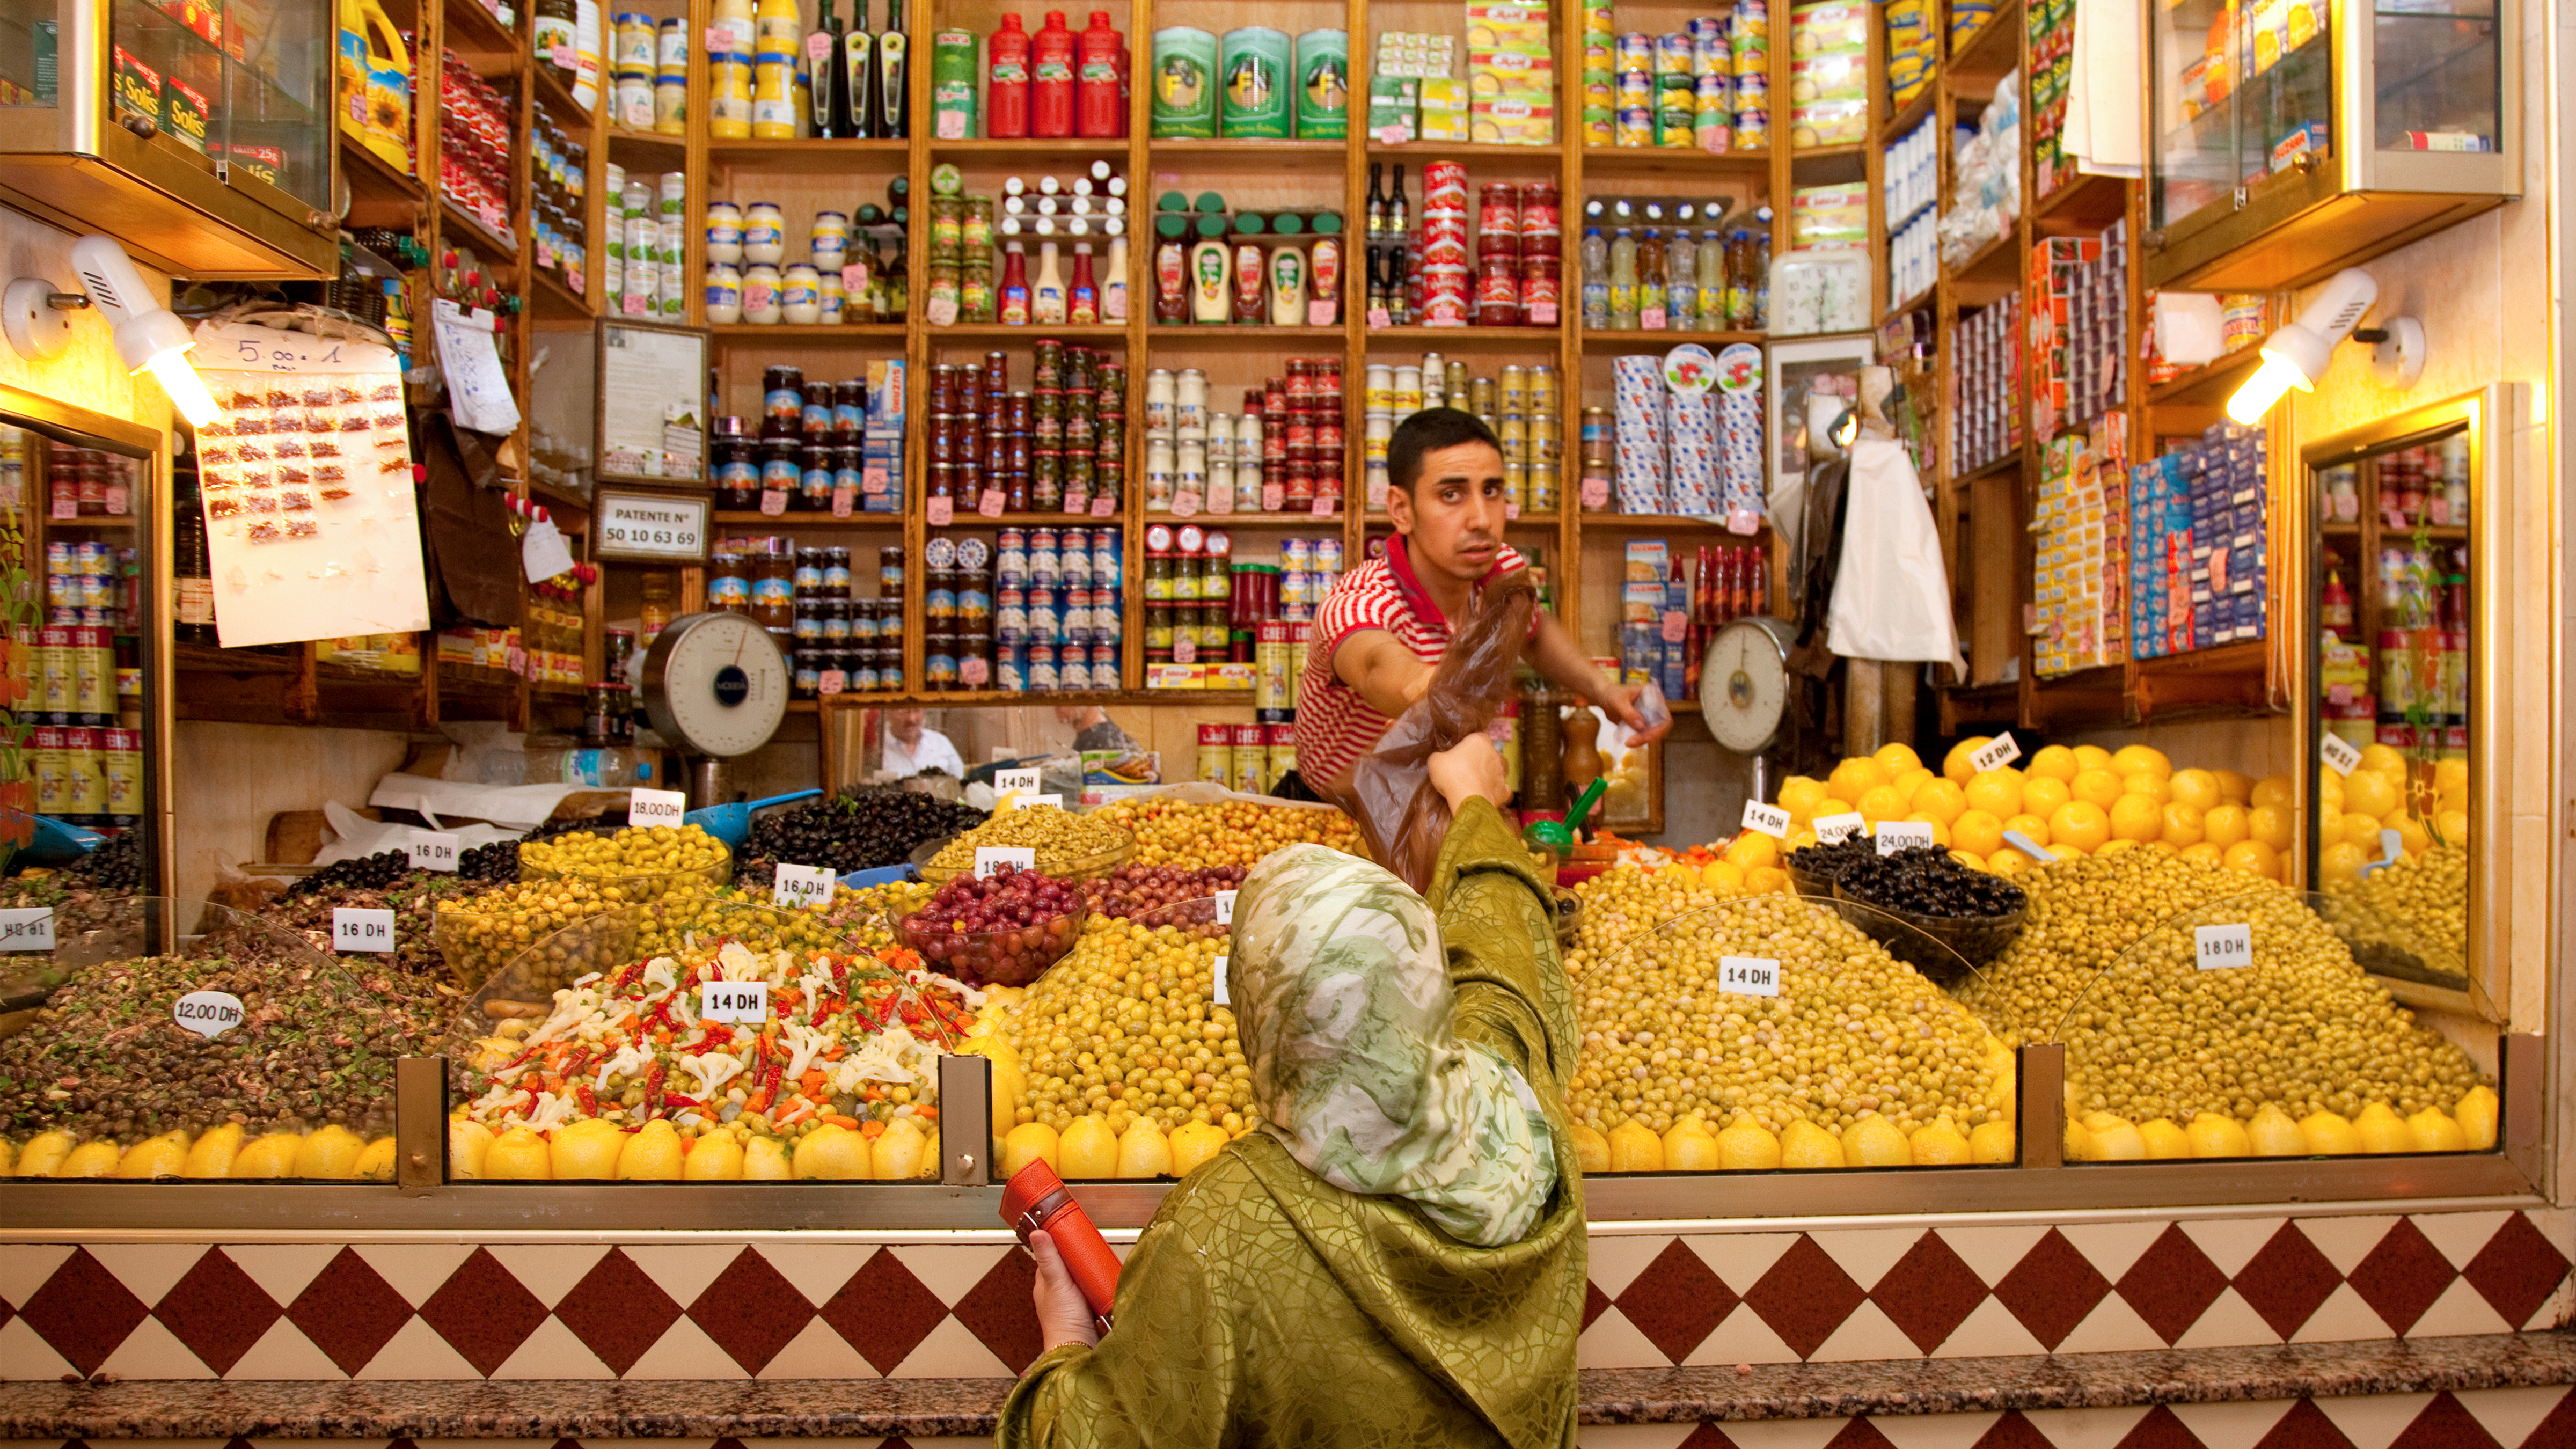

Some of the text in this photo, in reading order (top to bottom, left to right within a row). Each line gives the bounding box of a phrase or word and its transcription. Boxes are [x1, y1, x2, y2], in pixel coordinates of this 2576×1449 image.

[258, 148, 277, 162] 25g
[616, 509, 670, 523] PATENTE
[606, 528, 695, 545] 50 10 63 69
[1979, 742, 2011, 767] 12 DH
[1002, 777, 1034, 788] 14 DH
[635, 802, 679, 816] 18.00 DH
[1750, 809, 1783, 830] 14 DH
[1881, 835, 1929, 848] 24.00 DH
[416, 844, 451, 858] 16 DH
[783, 879, 824, 896] 16 DH
[342, 923, 385, 937] 16 DH
[2204, 939, 2244, 955] 18 DH
[1729, 967, 1771, 985] 14 DH
[712, 994, 758, 1009] 14 DH
[177, 1001, 239, 1022] 12.00 DH
